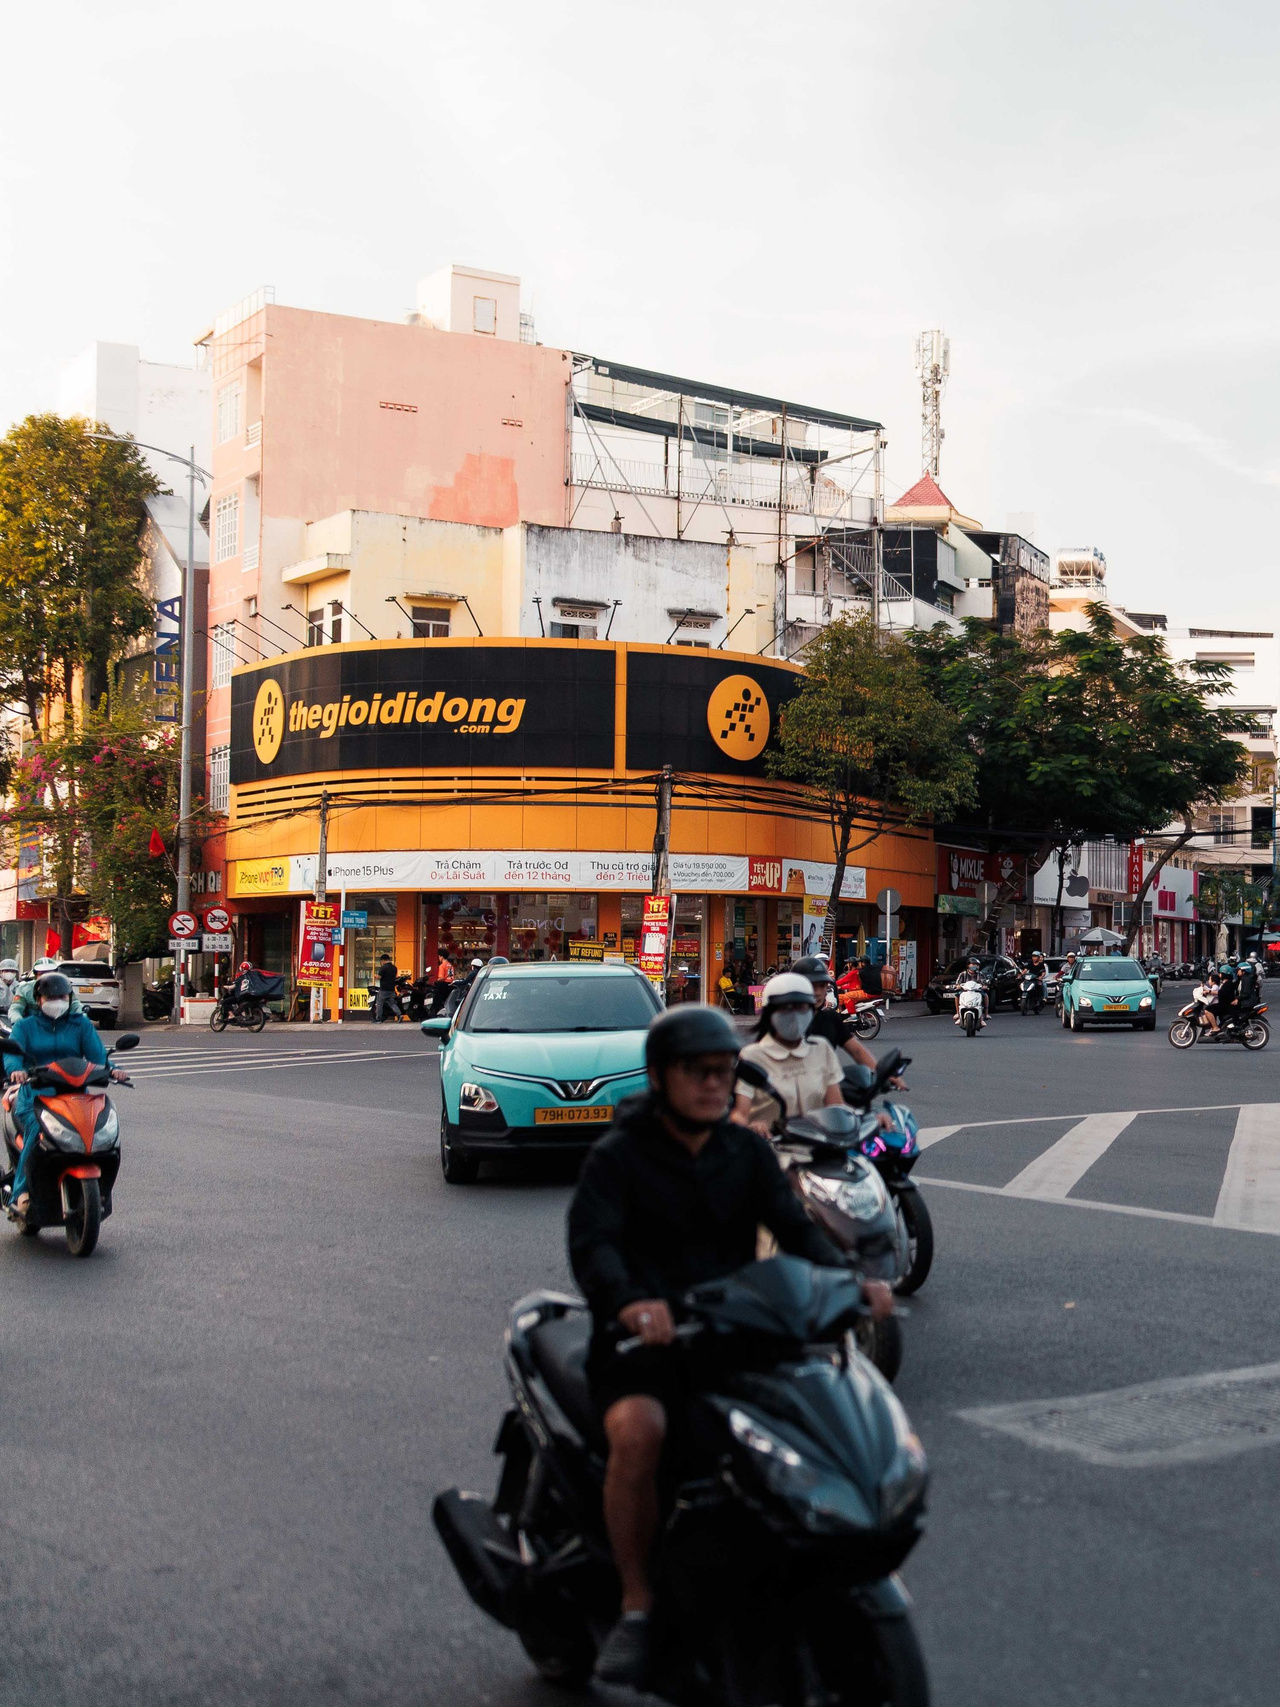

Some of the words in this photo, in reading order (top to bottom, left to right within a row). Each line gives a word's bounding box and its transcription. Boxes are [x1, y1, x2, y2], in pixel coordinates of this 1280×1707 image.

[288, 691, 526, 738] thegioididong
[333, 867, 361, 876] iPhone
[362, 866, 373, 876] 15
[374, 865, 394, 876] Plus
[435, 860, 450, 870] Trả
[451, 860, 481, 872] Chậm
[507, 860, 523, 870] Trả
[525, 860, 552, 870] trước
[590, 861, 609, 871] Thu
[613, 861, 624, 871] cũ
[626, 861, 639, 872] trợ
[672, 861, 684, 869] Giá
[960, 857, 985, 881] MIXUE
[462, 869, 486, 880] Suất
[504, 869, 524, 880] đến
[527, 871, 539, 880] 12
[541, 870, 571, 882] tháng
[595, 870, 615, 881] đến
[617, 872, 624, 881] 2
[627, 871, 650, 882] Triệu
[581, 947, 603, 958] REFUND
[483, 991, 508, 1000] TAXI
